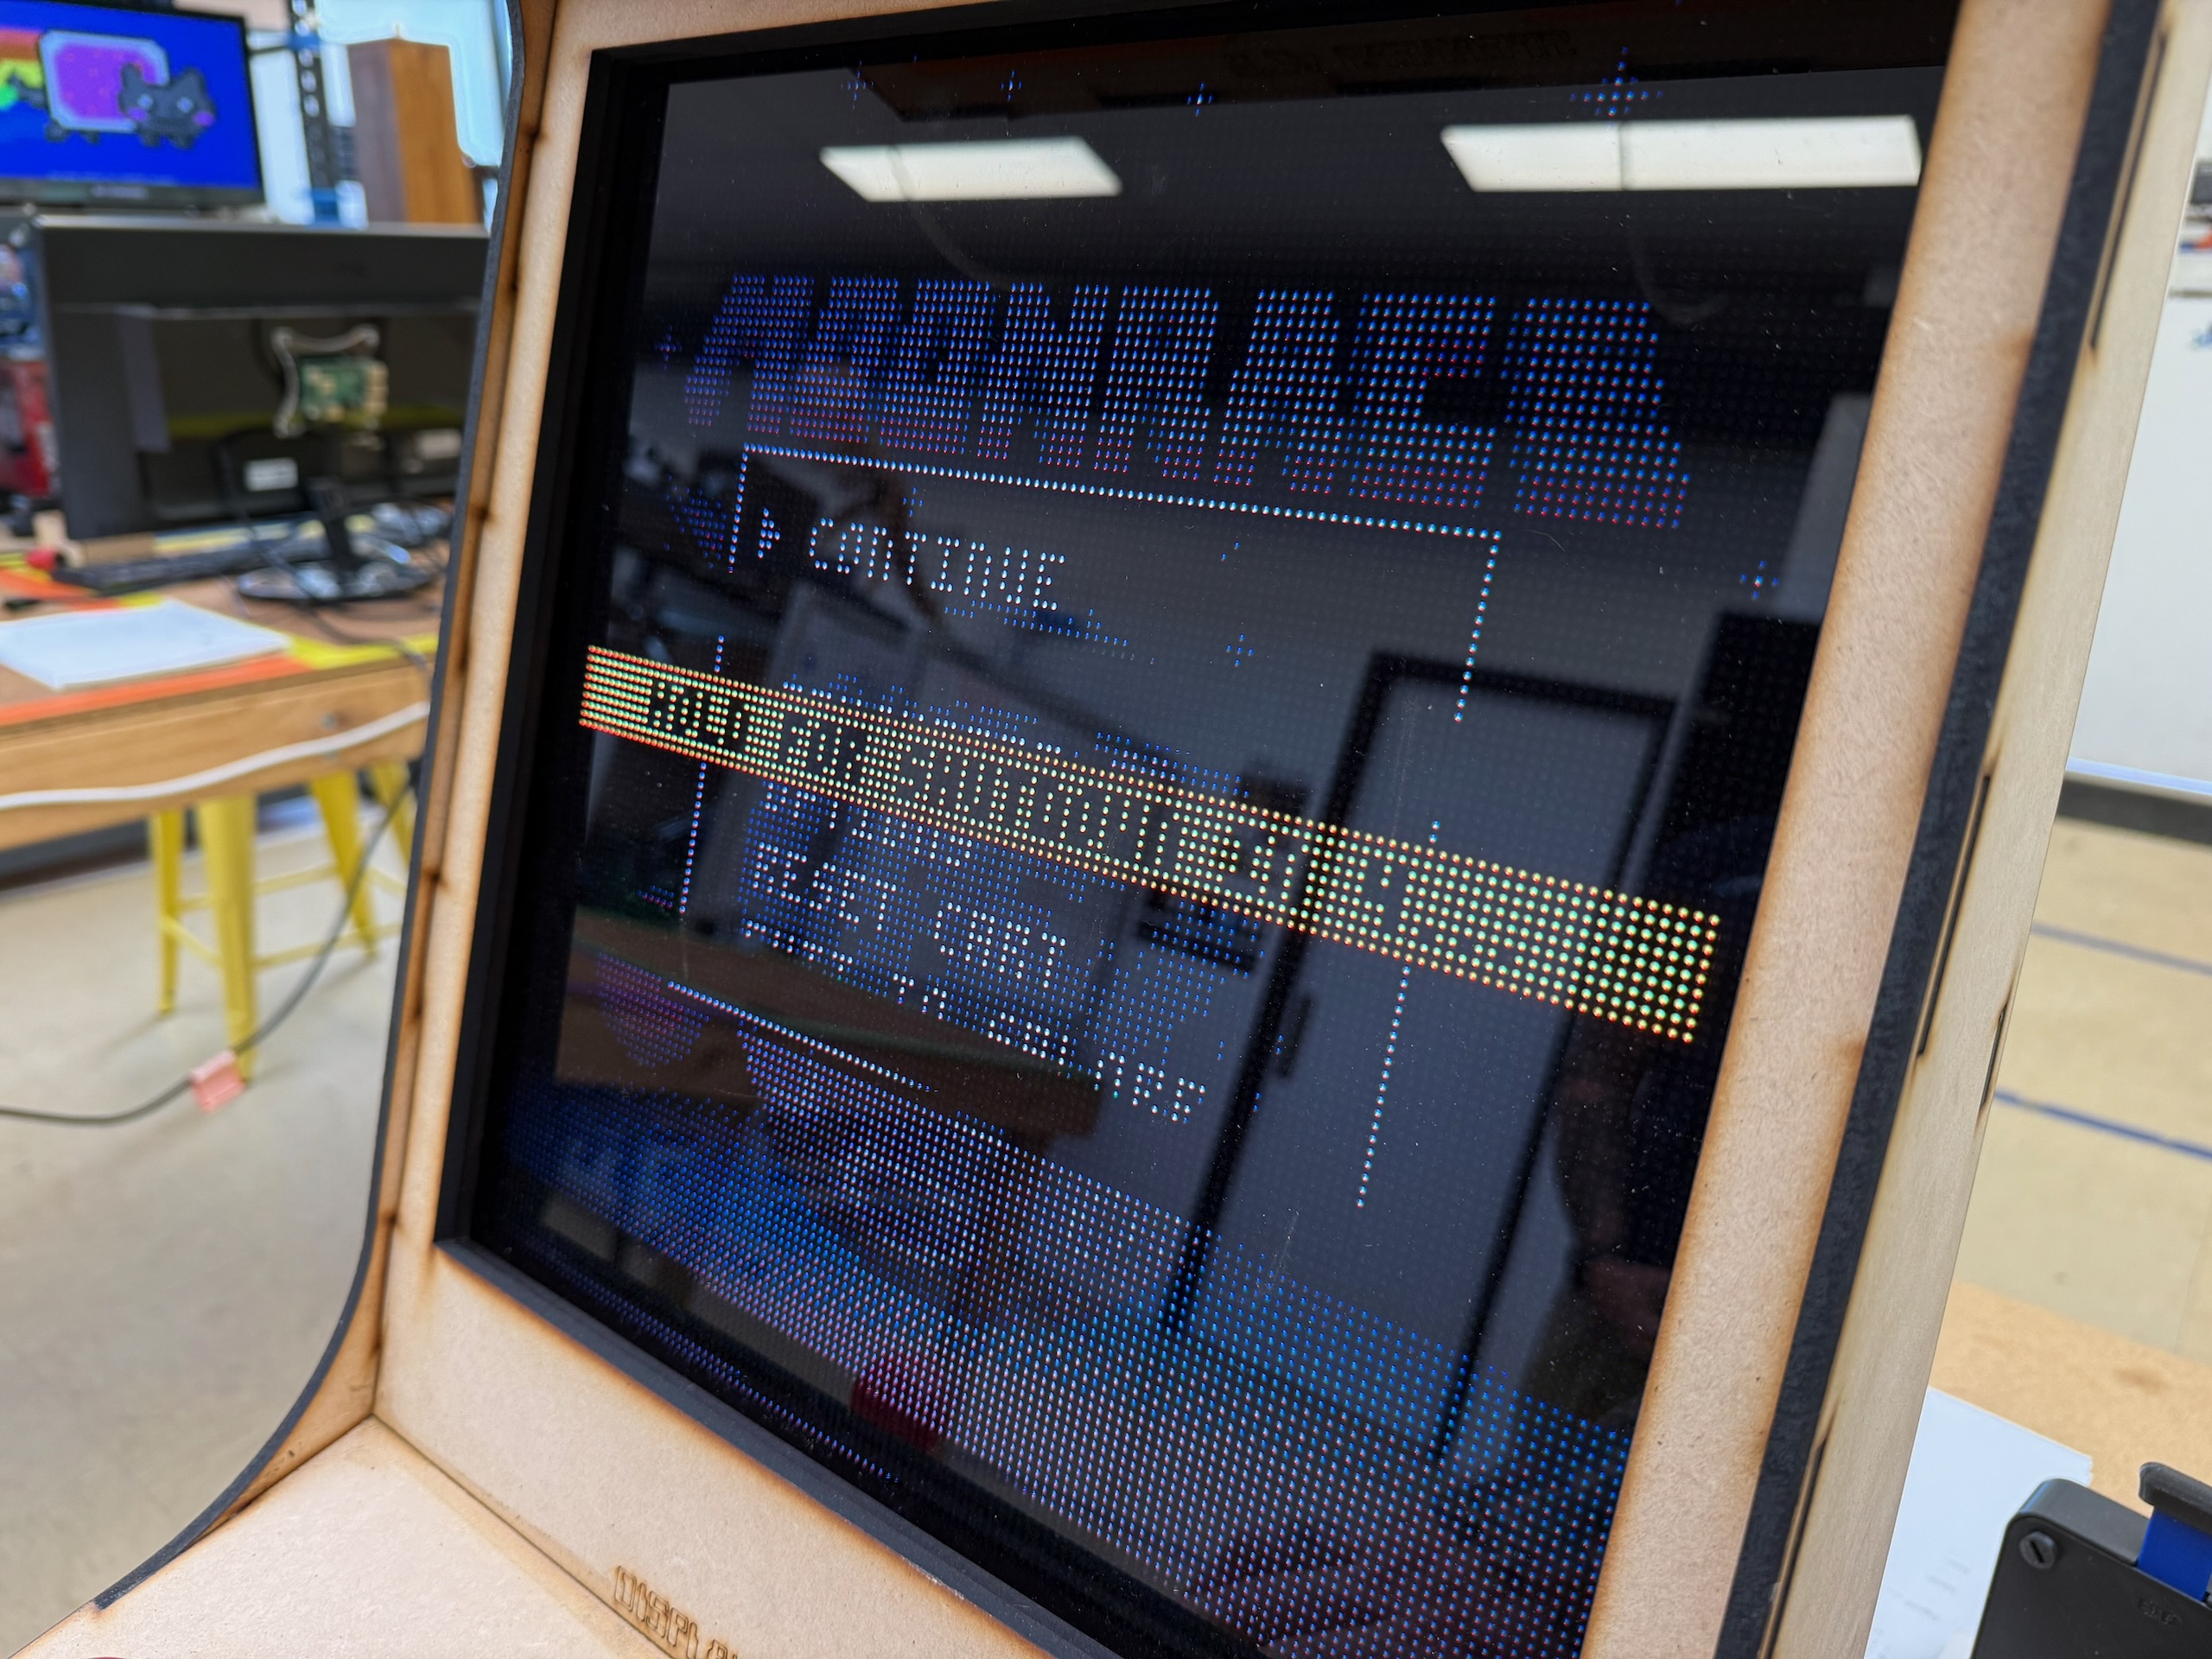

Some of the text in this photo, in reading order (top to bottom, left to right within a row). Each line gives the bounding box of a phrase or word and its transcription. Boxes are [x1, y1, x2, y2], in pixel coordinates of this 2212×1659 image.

[806, 517, 1067, 611] CONTINUE
[647, 677, 752, 753] HOLD
[779, 710, 867, 785] FOR
[897, 741, 1183, 872] SHUTDOWN
[752, 842, 898, 933] RESET
[931, 898, 1068, 990] CART
[614, 1565, 738, 1659] DISPL
